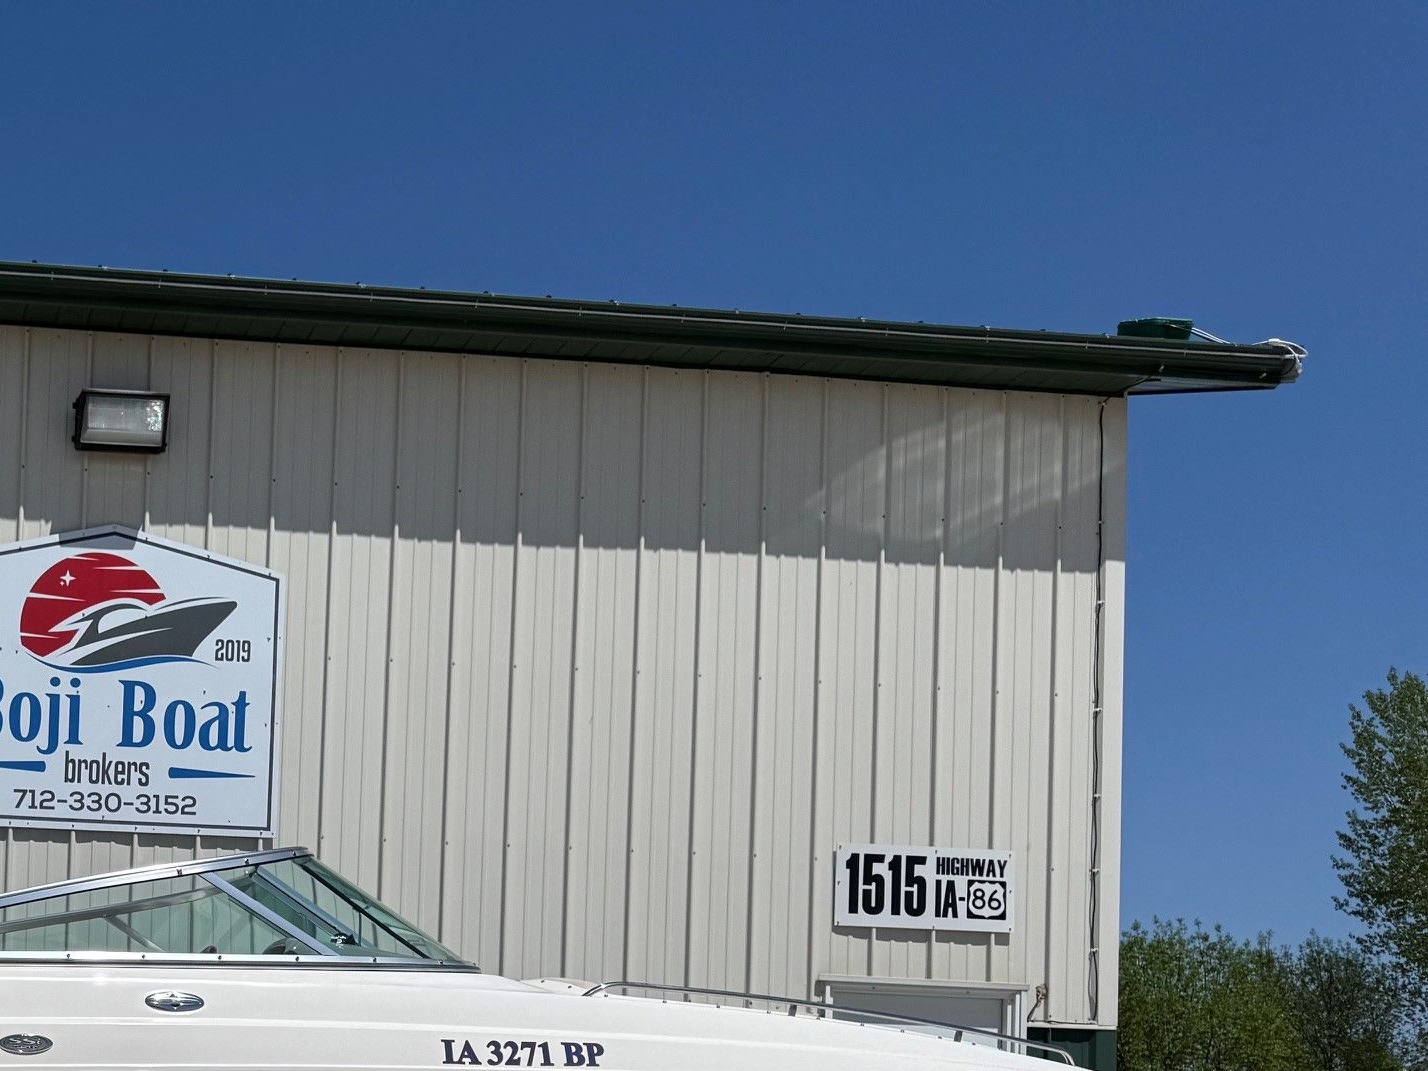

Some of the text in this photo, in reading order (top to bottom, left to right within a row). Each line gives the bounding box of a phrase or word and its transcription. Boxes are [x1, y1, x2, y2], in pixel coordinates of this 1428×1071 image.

[214, 639, 251, 663] 2019
[116, 679, 253, 753] Boat
[64, 750, 150, 786] brokers
[13, 788, 197, 816] 712-330-3152
[935, 856, 1008, 878] HIGHWAY
[845, 852, 928, 917] 1515
[440, 1039, 605, 1067] IA 3271 BP
